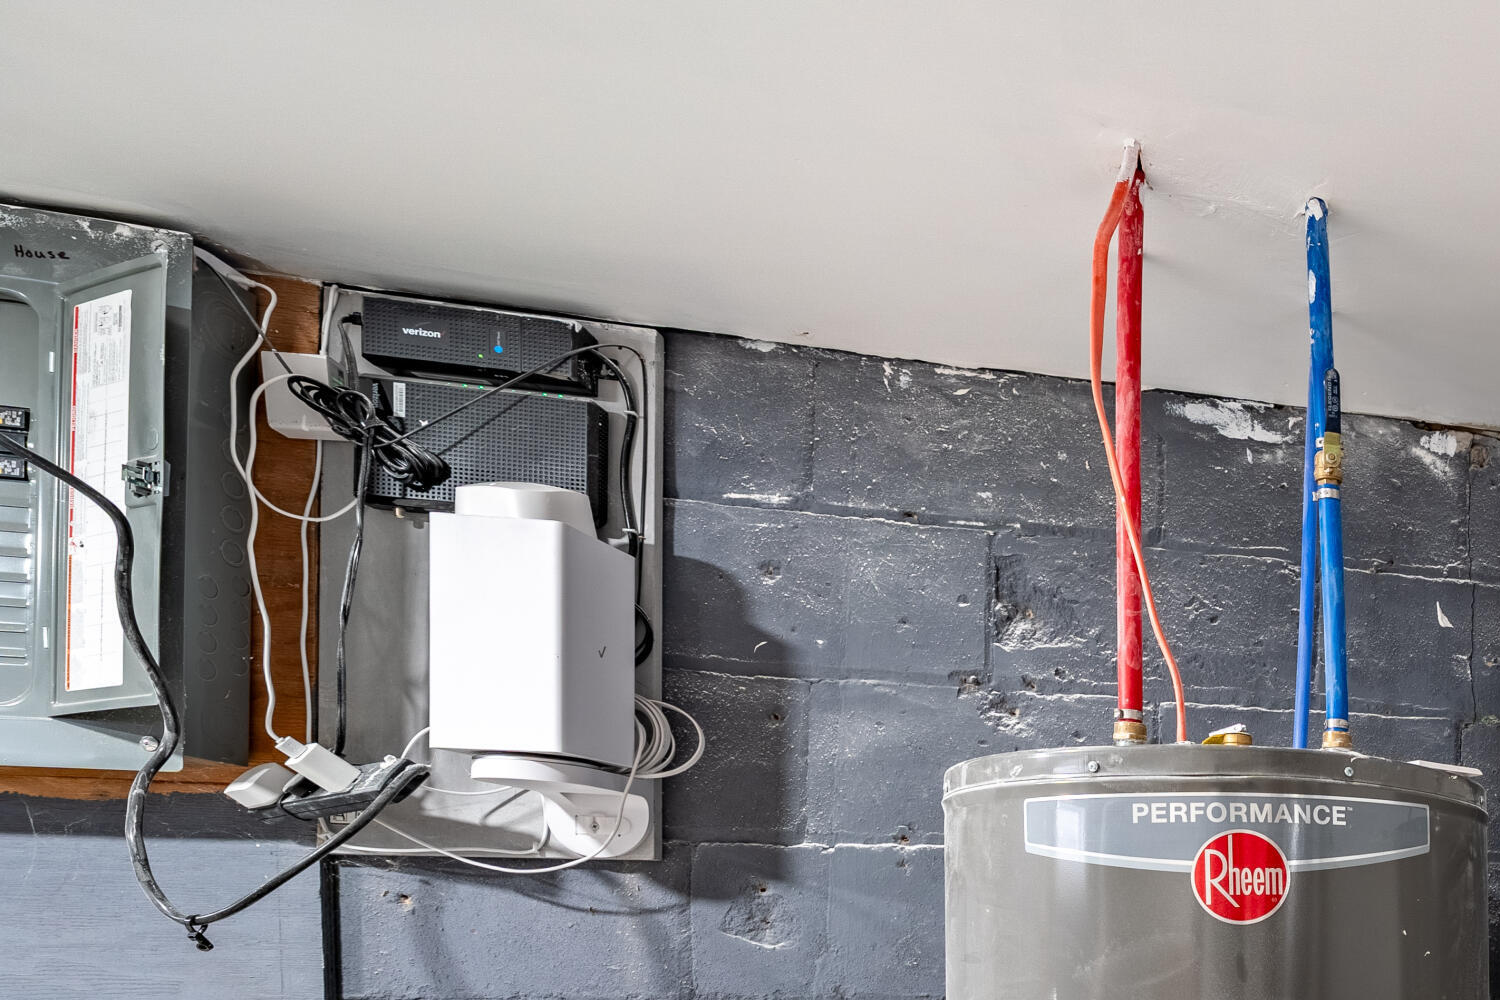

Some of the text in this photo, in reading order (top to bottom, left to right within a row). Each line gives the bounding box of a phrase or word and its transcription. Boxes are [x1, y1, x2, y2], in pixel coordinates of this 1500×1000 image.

[14, 244, 70, 259] House
[402, 326, 441, 339] verizon
[1132, 802, 1347, 826] PERFORMANCE
[1205, 834, 1283, 908] Rheem
